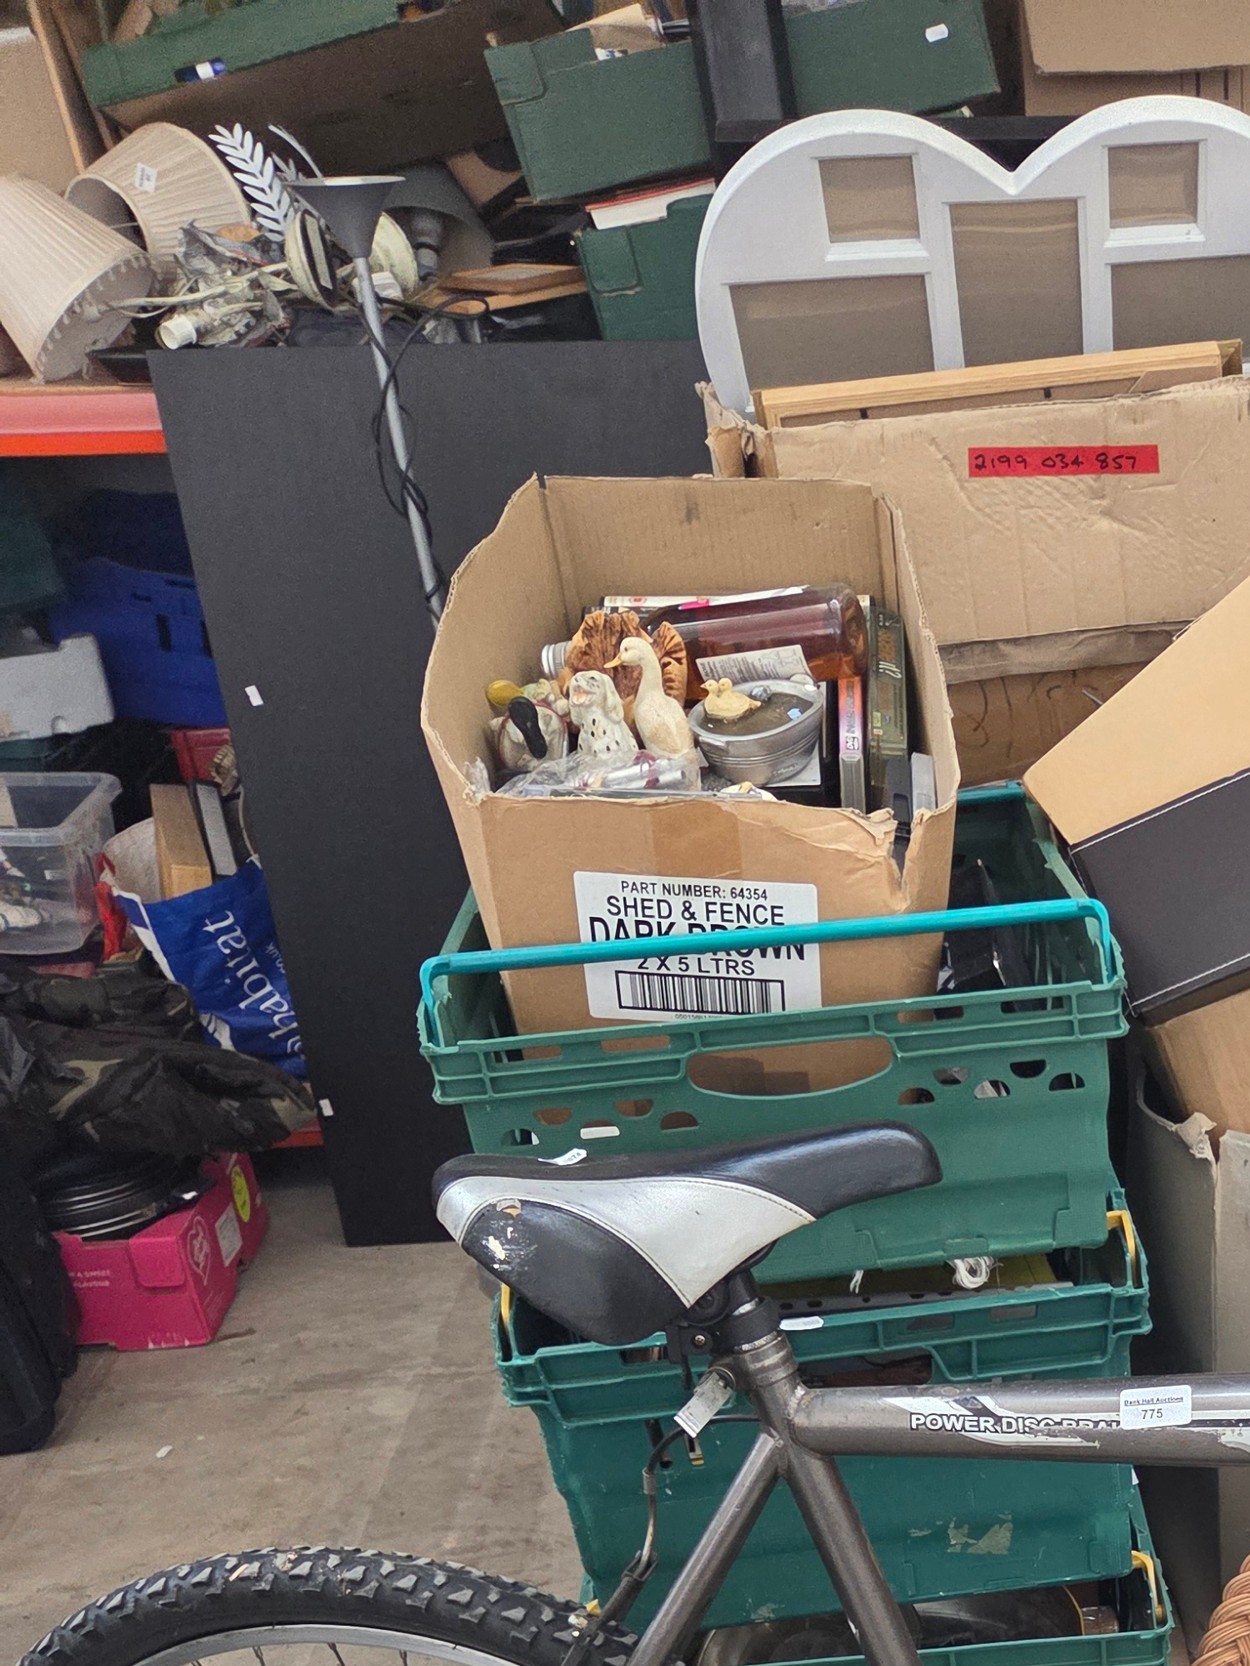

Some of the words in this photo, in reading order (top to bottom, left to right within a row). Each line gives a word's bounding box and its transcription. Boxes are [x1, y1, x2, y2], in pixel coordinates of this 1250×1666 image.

[974, 454, 1028, 470] 2199
[1041, 454, 1085, 469] 034
[1095, 453, 1137, 470] 857
[621, 880, 657, 895] PART
[661, 883, 726, 900] NUMBER:
[730, 886, 768, 901] 64354
[606, 895, 674, 921] SHED
[680, 899, 697, 921] &
[705, 901, 785, 926] FENCE
[589, 916, 677, 943] DARK
[203, 910, 299, 1040] habitat
[638, 956, 650, 970] 2
[656, 956, 671, 971] X
[678, 956, 691, 972] 5
[697, 957, 755, 976] LTRS
[910, 1412, 1000, 1435] POWER
[1141, 1408, 1164, 1420] 775
